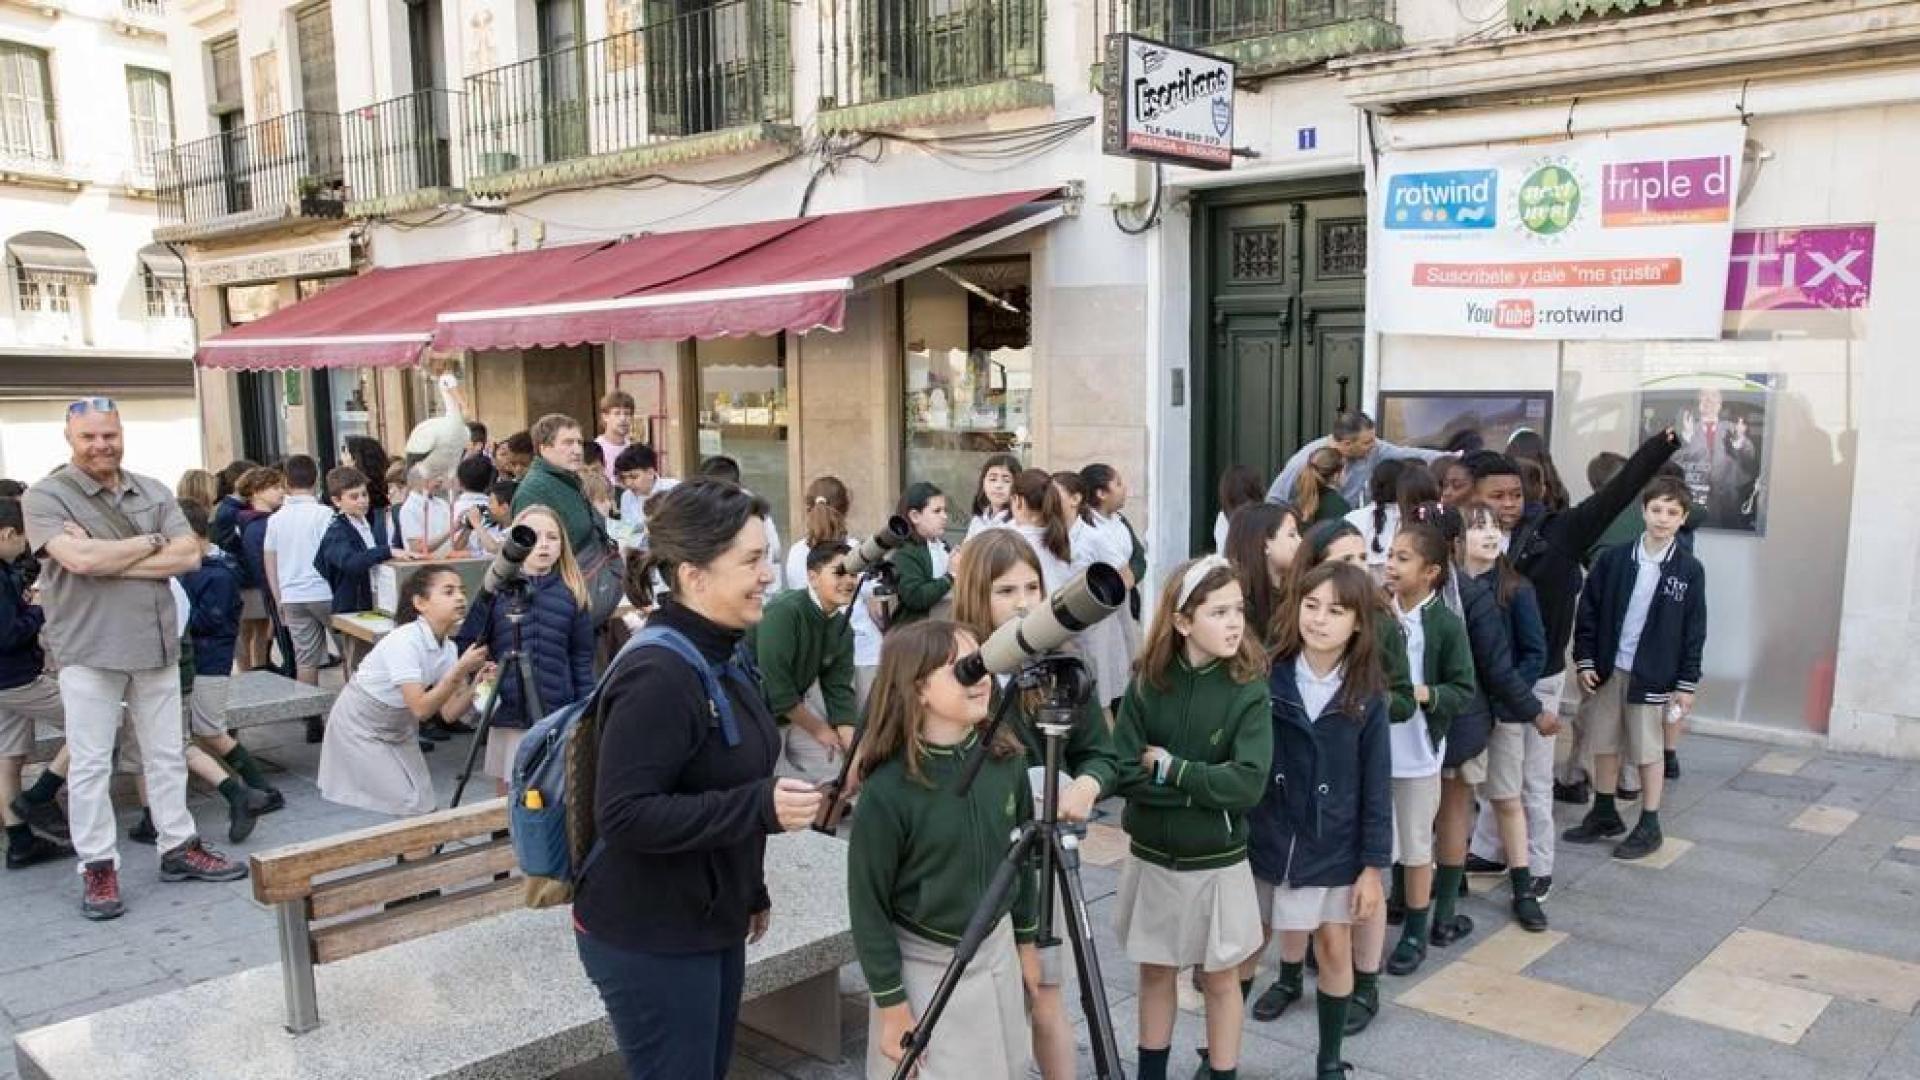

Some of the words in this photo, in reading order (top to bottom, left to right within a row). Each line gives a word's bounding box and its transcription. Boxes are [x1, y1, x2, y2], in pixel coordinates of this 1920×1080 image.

[1395, 178, 1489, 205] rotwind
[1608, 160, 1692, 213] triple
[1704, 156, 1725, 196] d
[1519, 271, 1529, 286] y
[1533, 267, 1567, 282] dale
